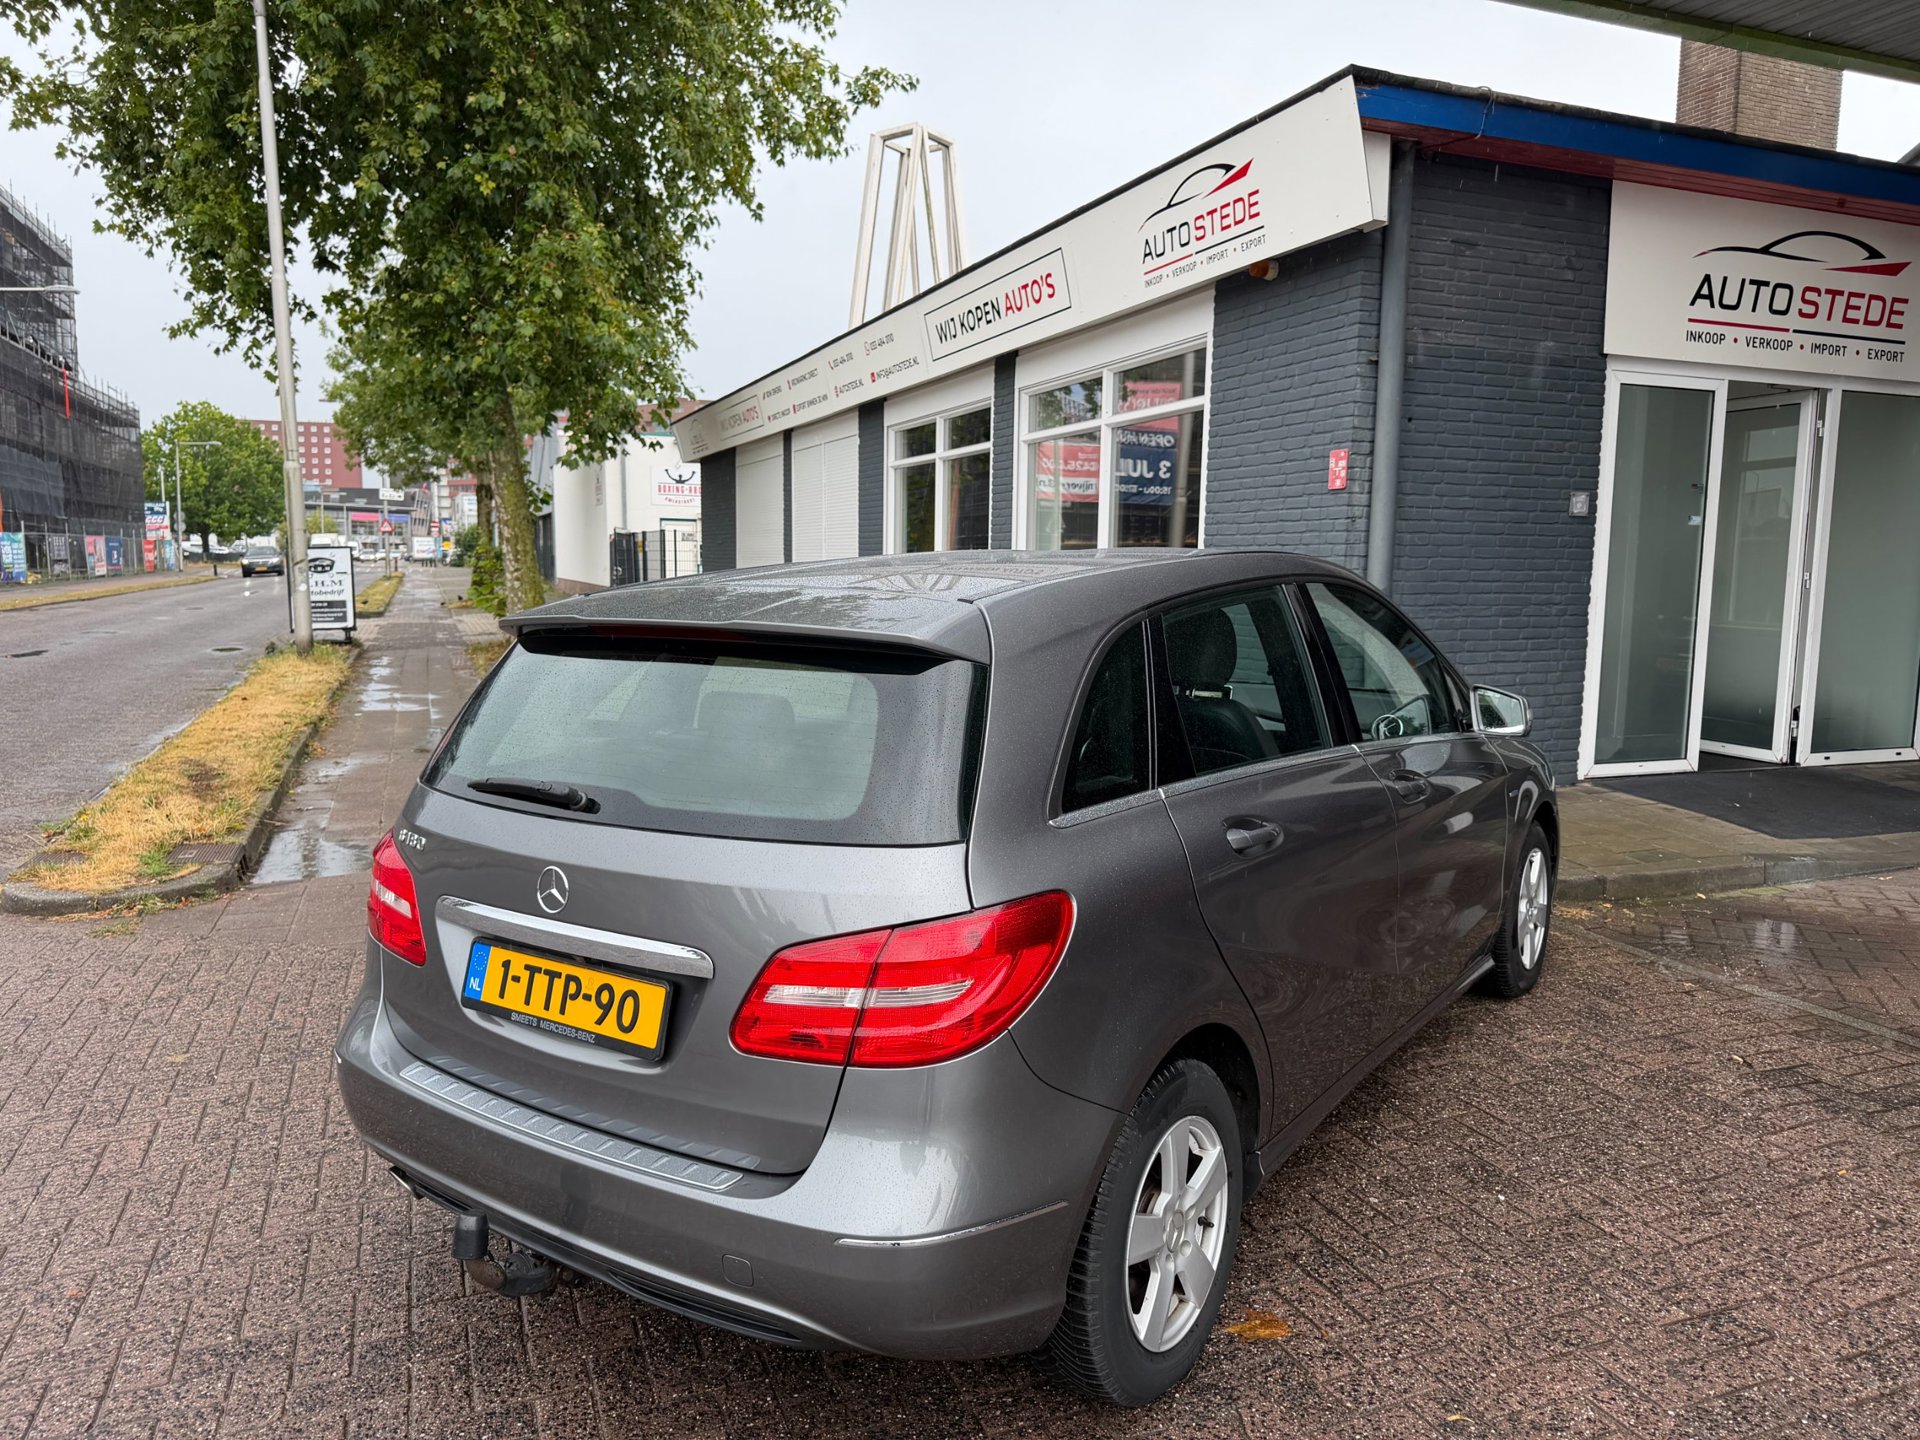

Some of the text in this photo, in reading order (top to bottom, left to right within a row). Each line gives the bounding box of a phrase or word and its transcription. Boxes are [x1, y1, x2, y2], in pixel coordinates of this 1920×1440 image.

[1144, 234, 1267, 288] INKOOP VERKOOP IMPORT EXPORT
[935, 272, 1057, 345] WIJ KOPEN AUTO'S
[1686, 330, 1905, 363] INKOOP VERKOOP IMPORT EXPORT
[310, 589, 344, 597] tobedrijf
[469, 976, 481, 992] NL
[498, 958, 640, 1034] 1-TTP-90
[510, 1011, 596, 1044] SMEETS MERCEDES-BENZ
